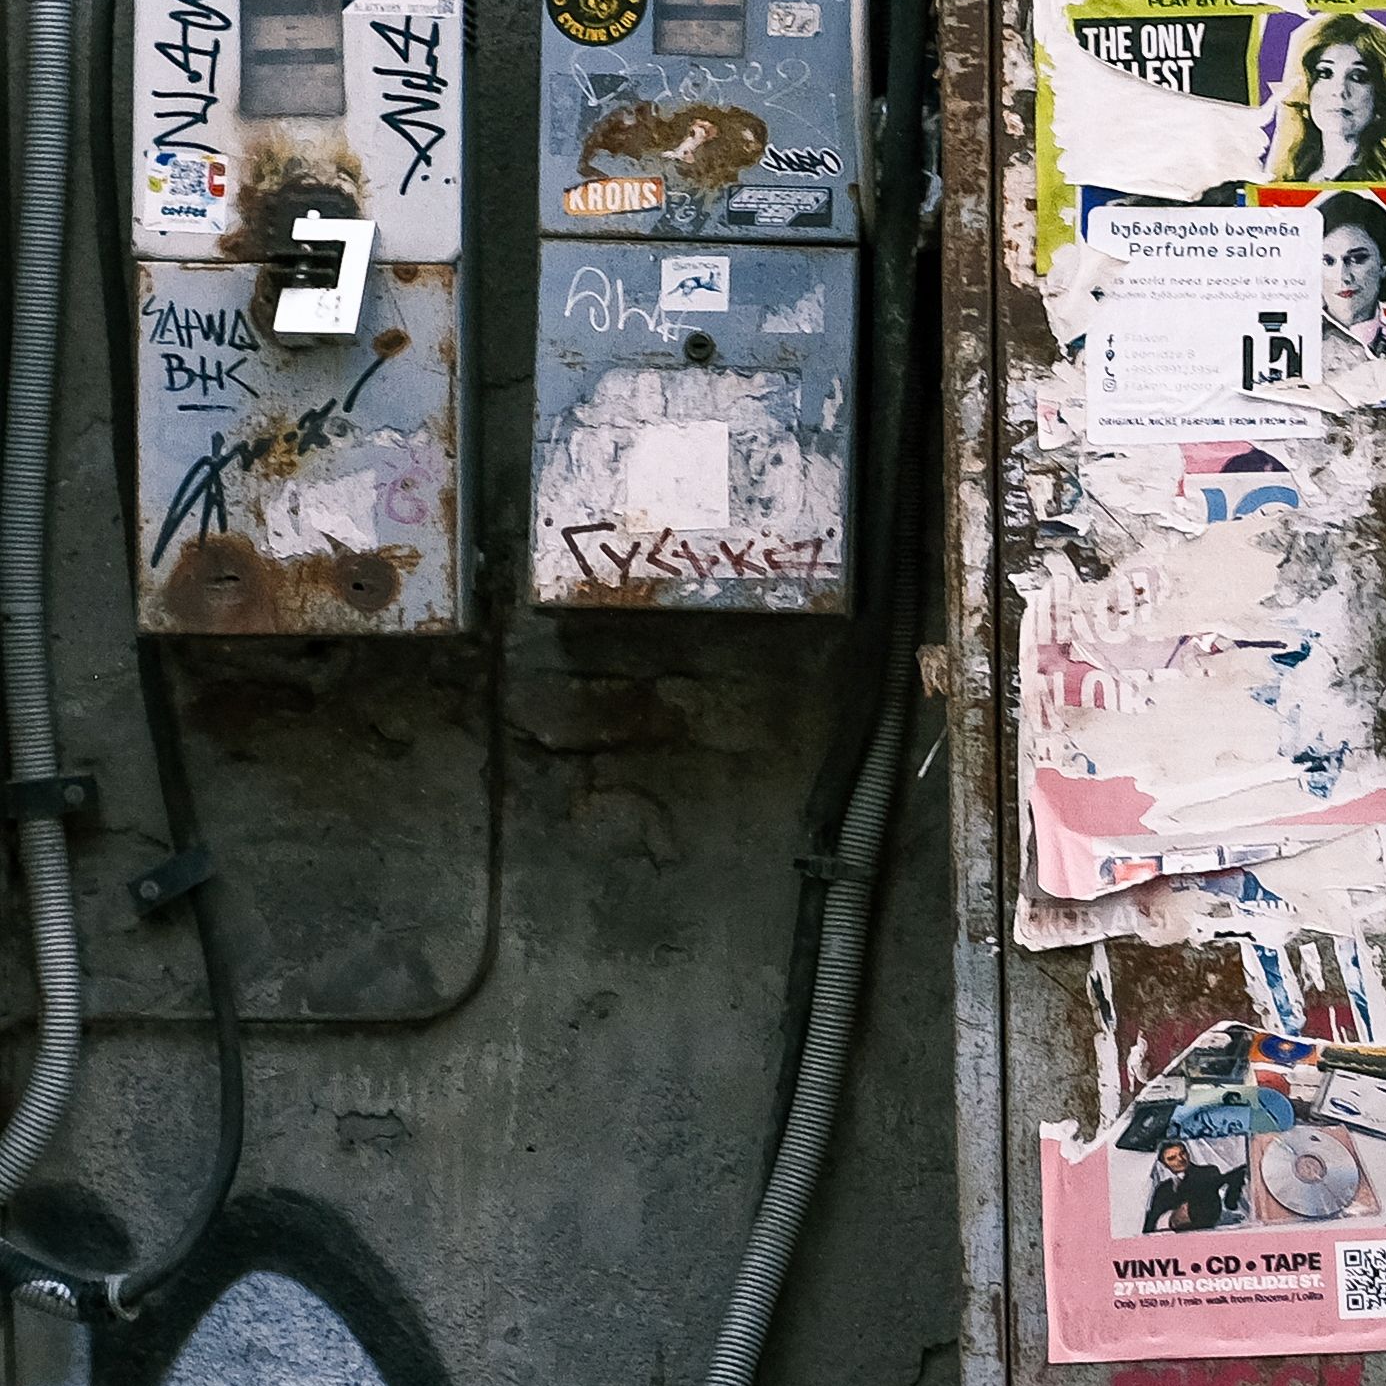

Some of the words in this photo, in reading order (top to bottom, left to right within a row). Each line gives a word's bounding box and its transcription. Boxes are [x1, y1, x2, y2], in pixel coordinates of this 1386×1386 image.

[1081, 24, 1134, 61] THE
[1140, 22, 1206, 60] ONLY
[568, 179, 660, 213] KRONS
[1110, 221, 1219, 240] სუნამოების
[1225, 221, 1301, 239] სალონი
[1129, 241, 1219, 257] Perfume
[1225, 242, 1282, 258] salon
[1112, 1258, 1187, 1279] VINYL
[1205, 1255, 1241, 1276] CD
[1260, 1251, 1323, 1273] TAPE
[1113, 1280, 1134, 1297] 27
[1135, 1278, 1195, 1296] TAMAR
[1299, 1273, 1325, 1288] ST.
